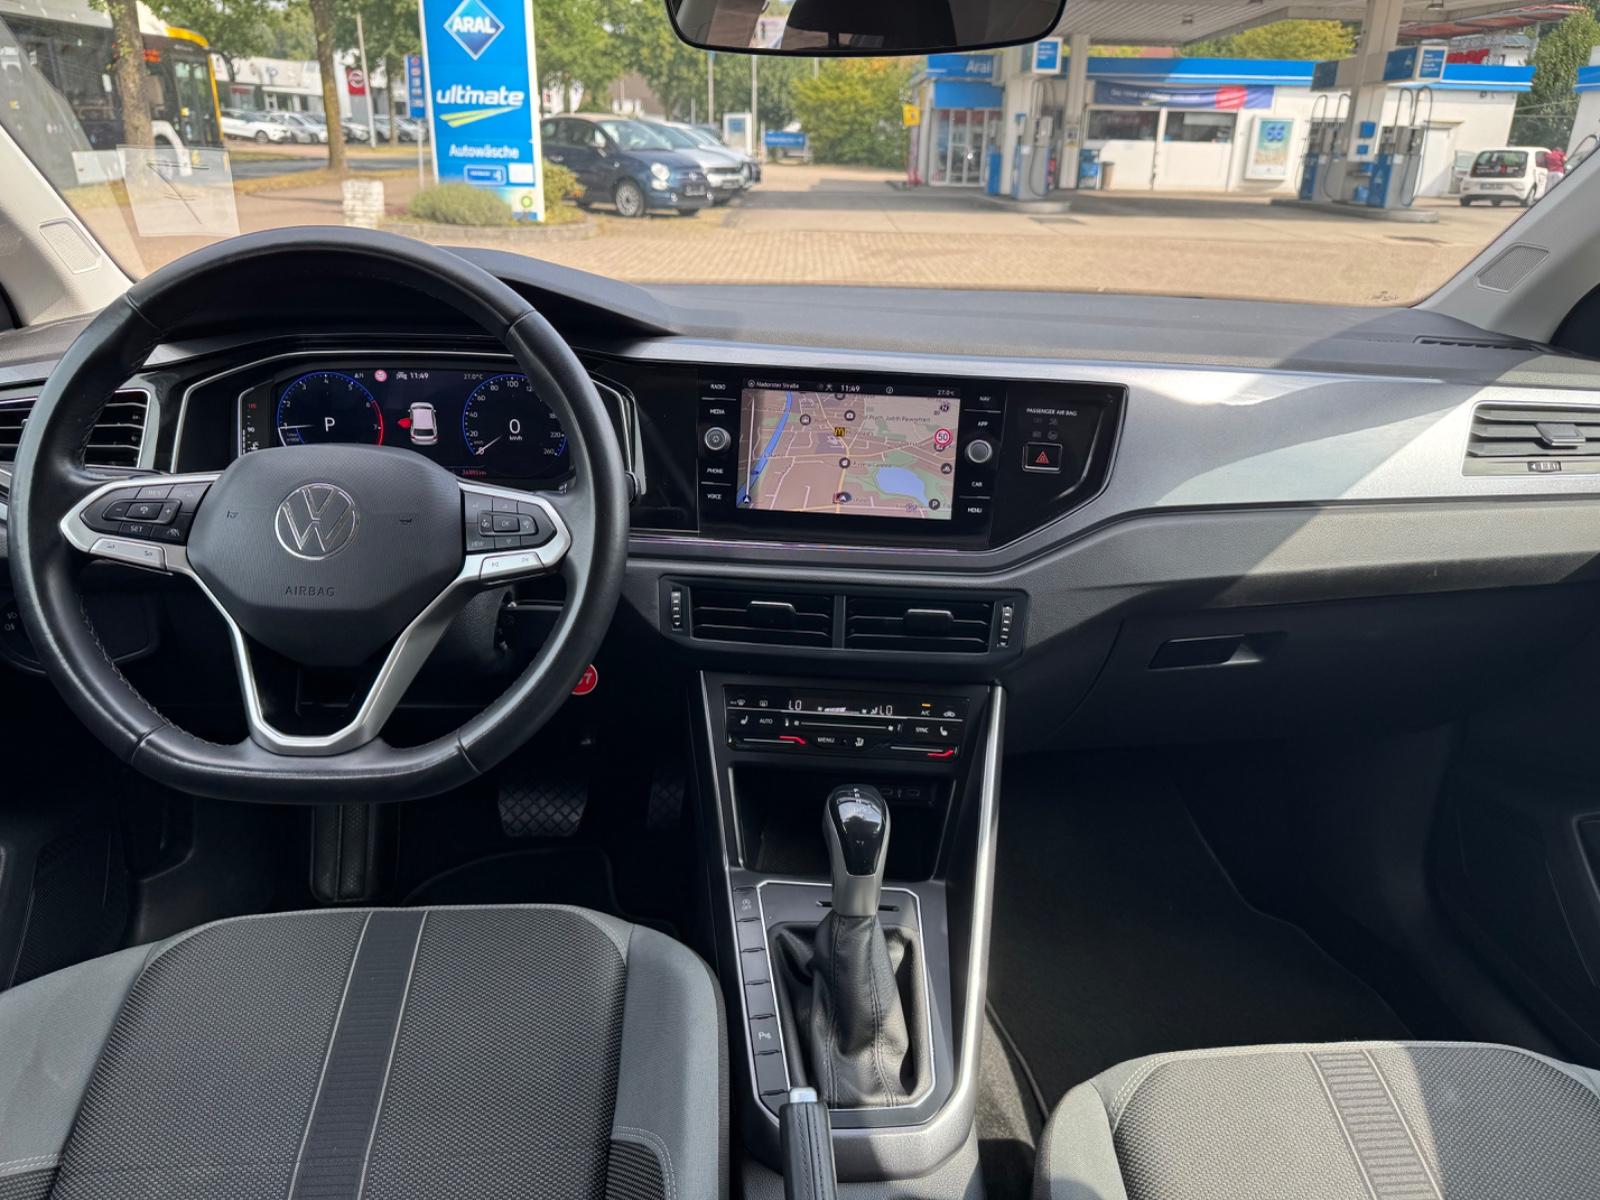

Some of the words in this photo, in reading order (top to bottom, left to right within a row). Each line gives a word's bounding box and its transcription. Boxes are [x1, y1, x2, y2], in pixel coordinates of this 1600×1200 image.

[451, 16, 496, 33] ARAL
[965, 59, 992, 74] Aral
[436, 85, 525, 107] ultimate
[449, 144, 520, 159] Autowäsche
[490, 384, 499, 392] 80
[506, 380, 520, 388] 100
[840, 384, 860, 392] 11:49
[1026, 407, 1055, 415] PASSENGER
[324, 417, 336, 432] P
[509, 418, 521, 434] 0
[469, 430, 478, 438] 20
[938, 433, 948, 441] 50
[130, 525, 143, 533] SET
[284, 584, 336, 598] AIRBAG
[788, 700, 802, 711] LO
[879, 705, 893, 716] LO
